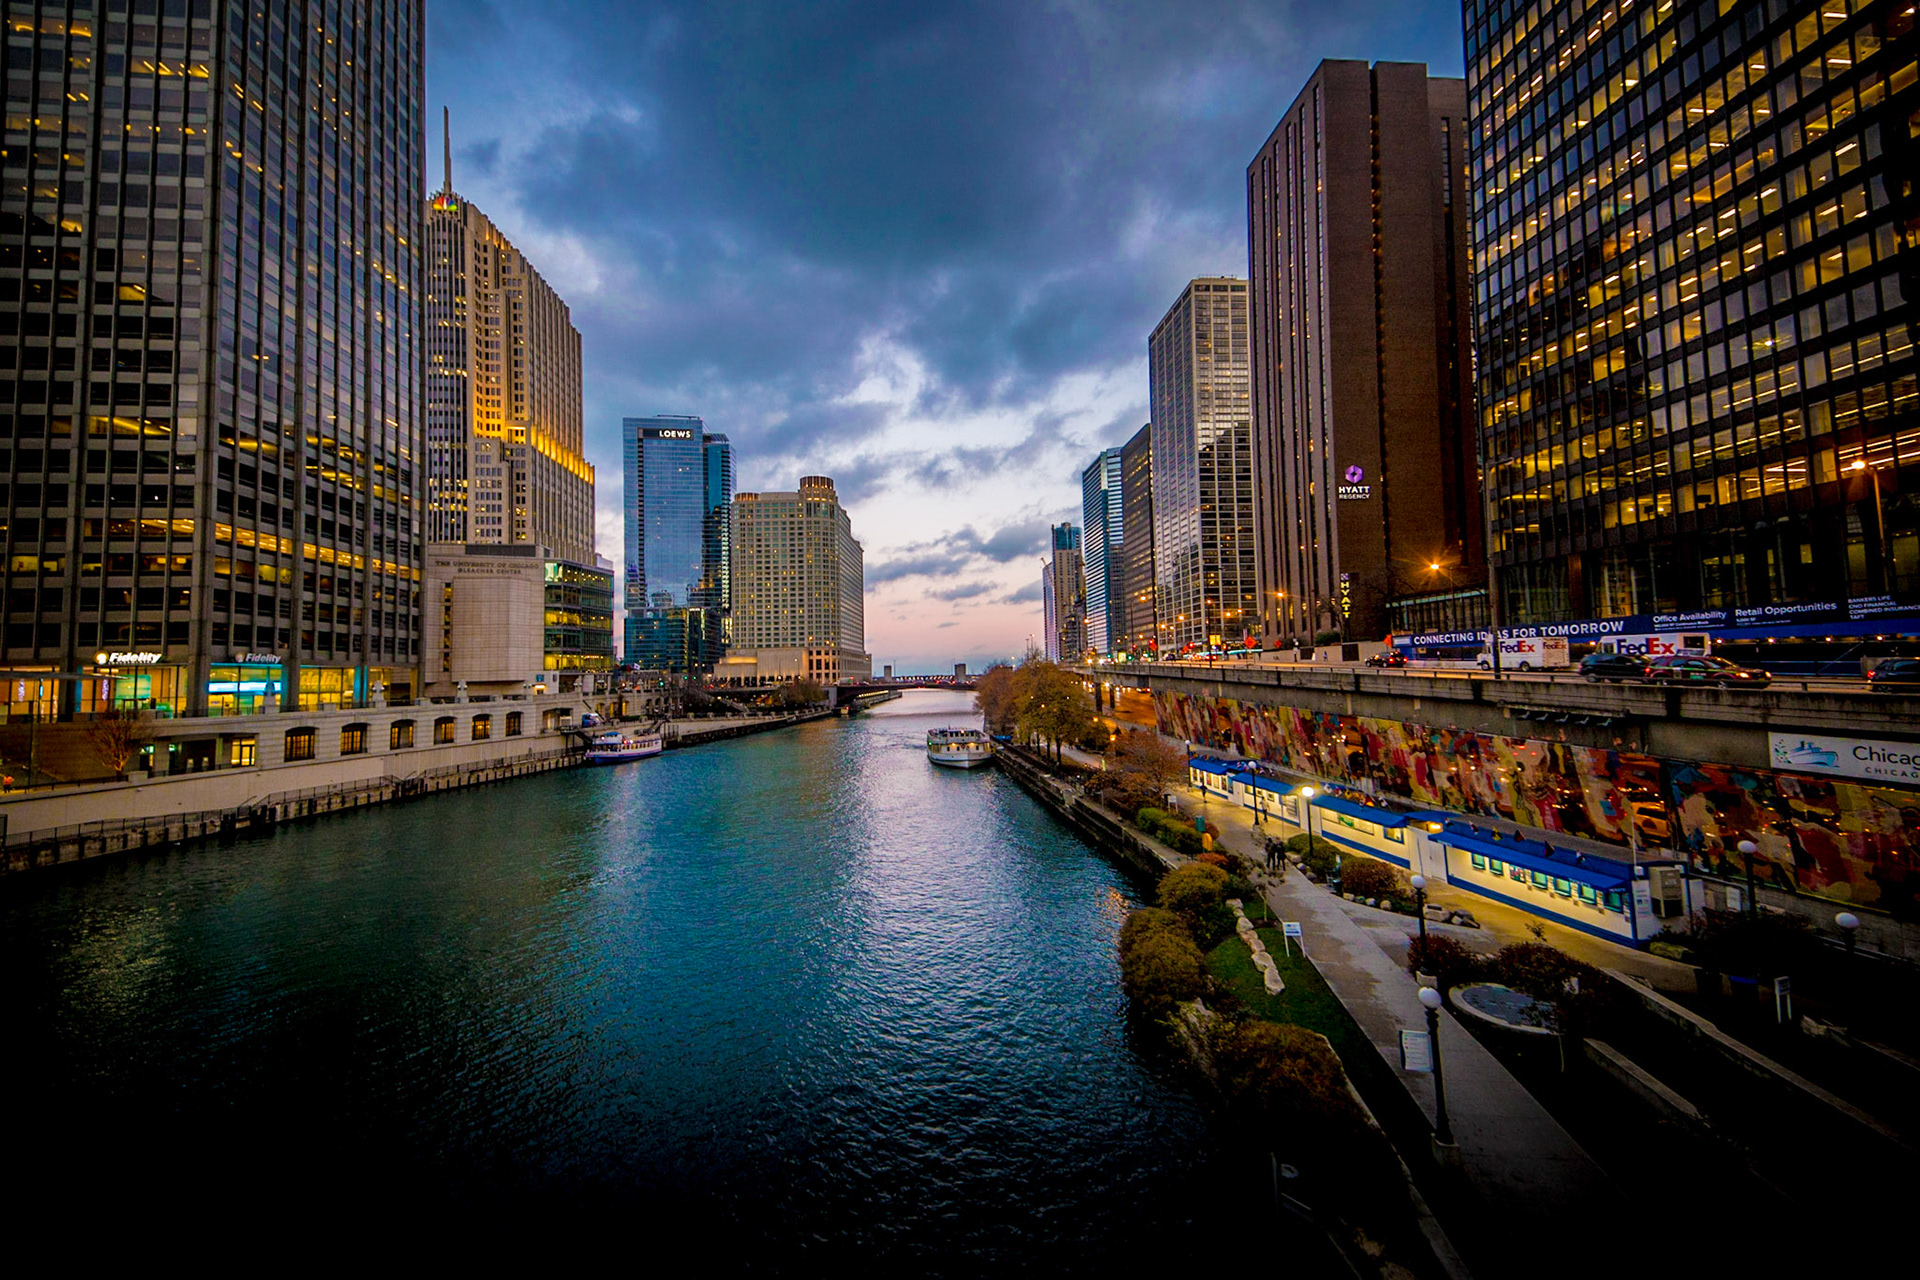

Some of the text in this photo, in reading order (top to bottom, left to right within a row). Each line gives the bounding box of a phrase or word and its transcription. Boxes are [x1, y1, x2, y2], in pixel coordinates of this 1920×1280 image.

[659, 430, 691, 439] LOEWS
[1338, 486, 1370, 494] HYATT
[1340, 581, 1351, 619] HYATT
[1735, 602, 1838, 617] Retail Opportunities
[1653, 615, 1679, 623] Office
[1679, 611, 1727, 622] Availability
[1413, 632, 1475, 645] CONNECTING
[1512, 628, 1537, 638] FOR
[1540, 620, 1625, 637] TOMORROW
[1500, 641, 1535, 653] FedEx
[1543, 641, 1568, 650] FedEx
[1616, 638, 1675, 656] FedEx
[108, 651, 163, 664] Fidelity
[244, 652, 281, 664] Fidelity
